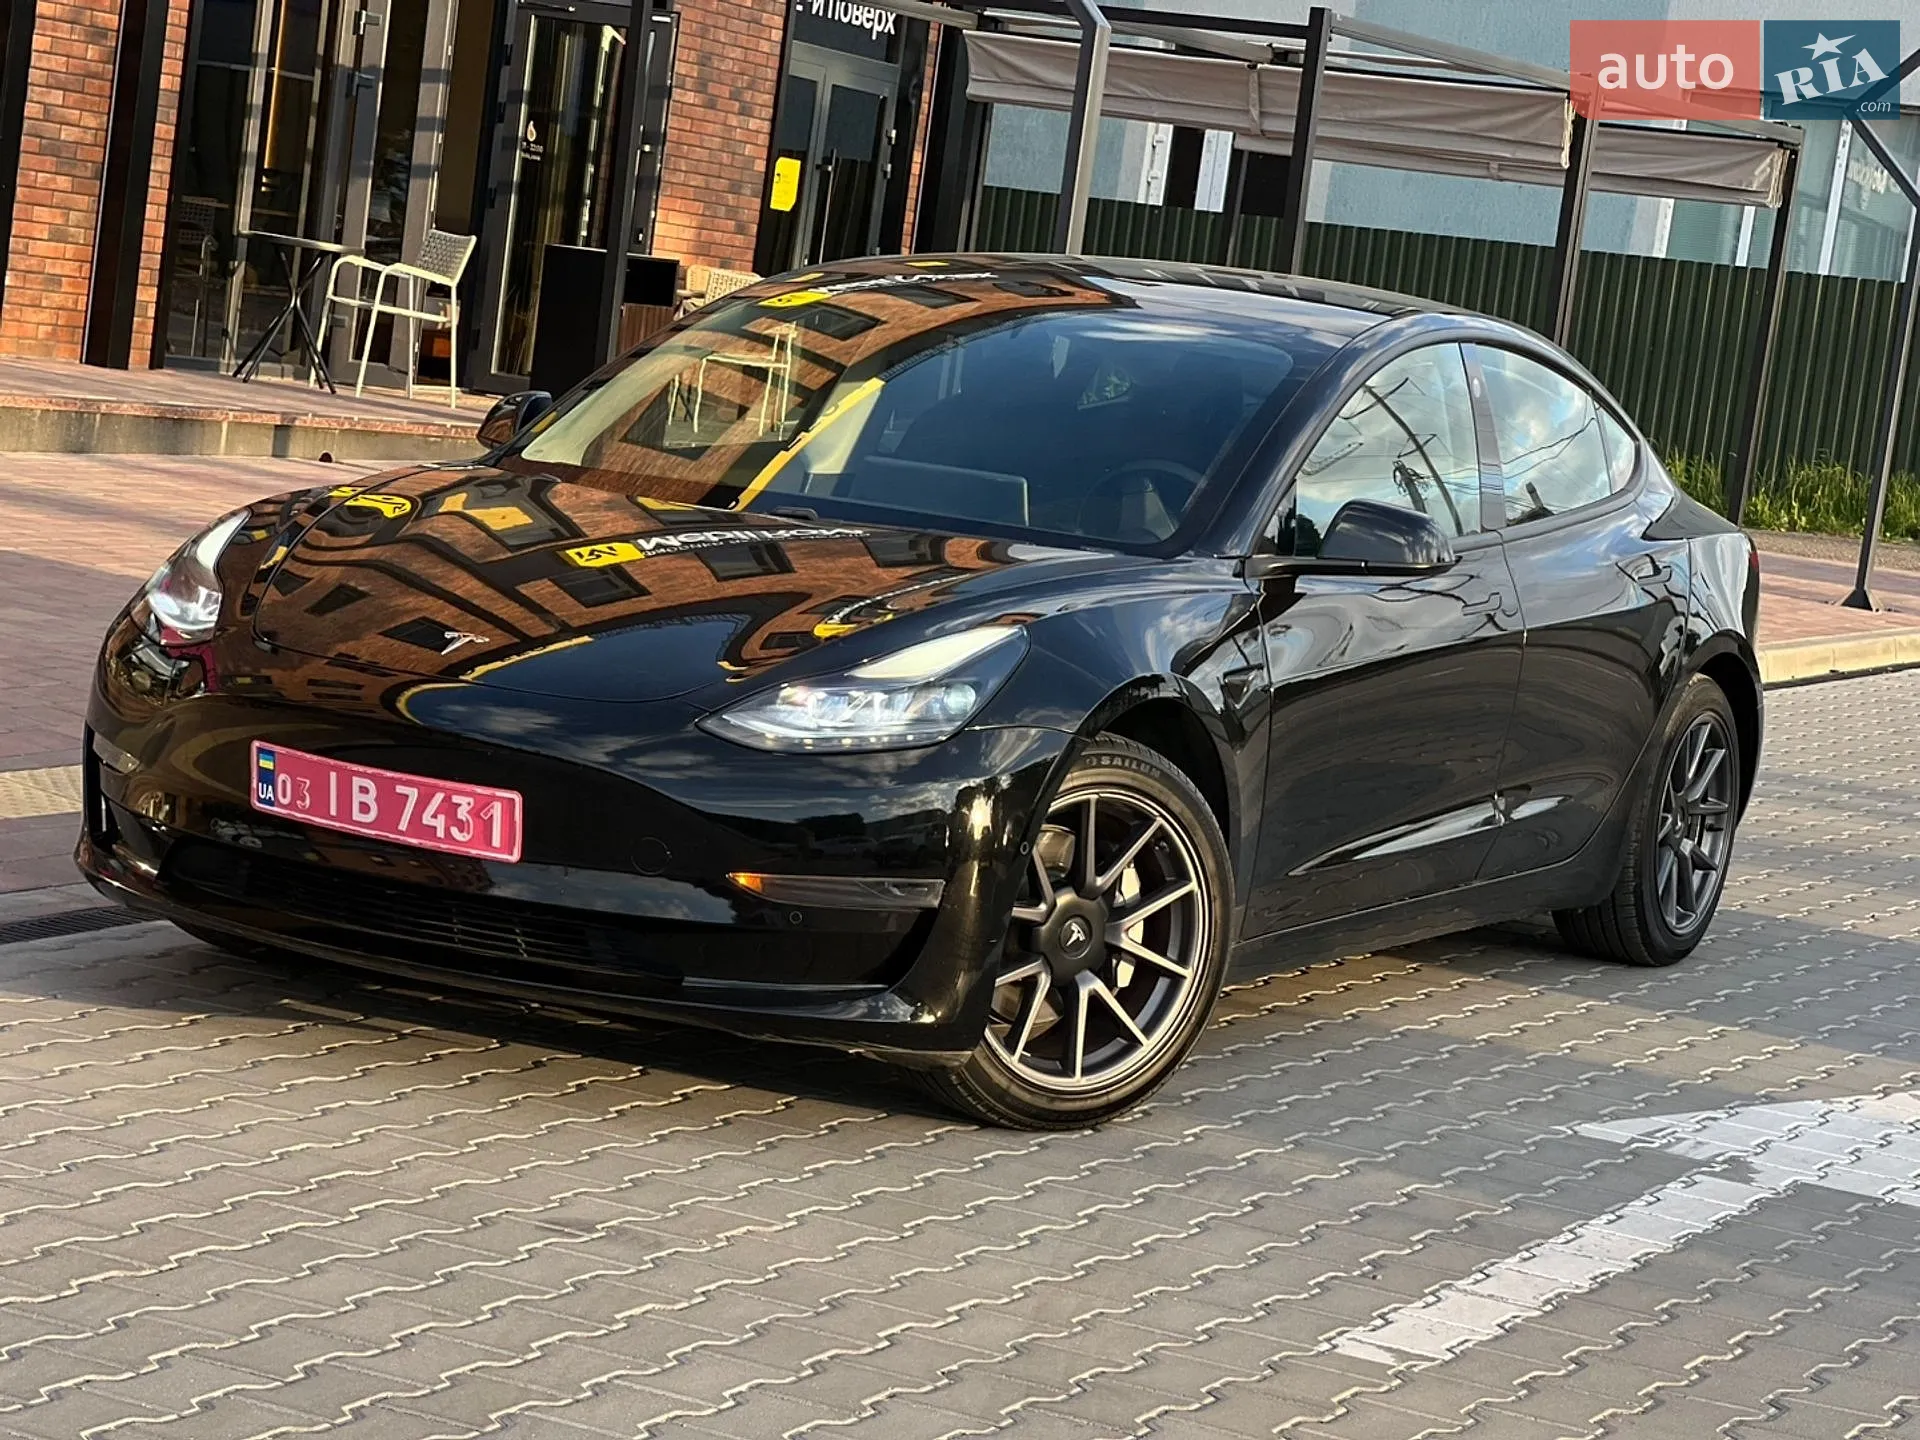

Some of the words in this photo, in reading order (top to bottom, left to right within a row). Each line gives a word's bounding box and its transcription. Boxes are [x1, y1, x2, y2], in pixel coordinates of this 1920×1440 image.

[827, 0, 896, 40] поверх
[258, 782, 275, 802] UA
[277, 772, 311, 810] 03
[329, 771, 378, 824] IB
[395, 784, 502, 848] 7431
